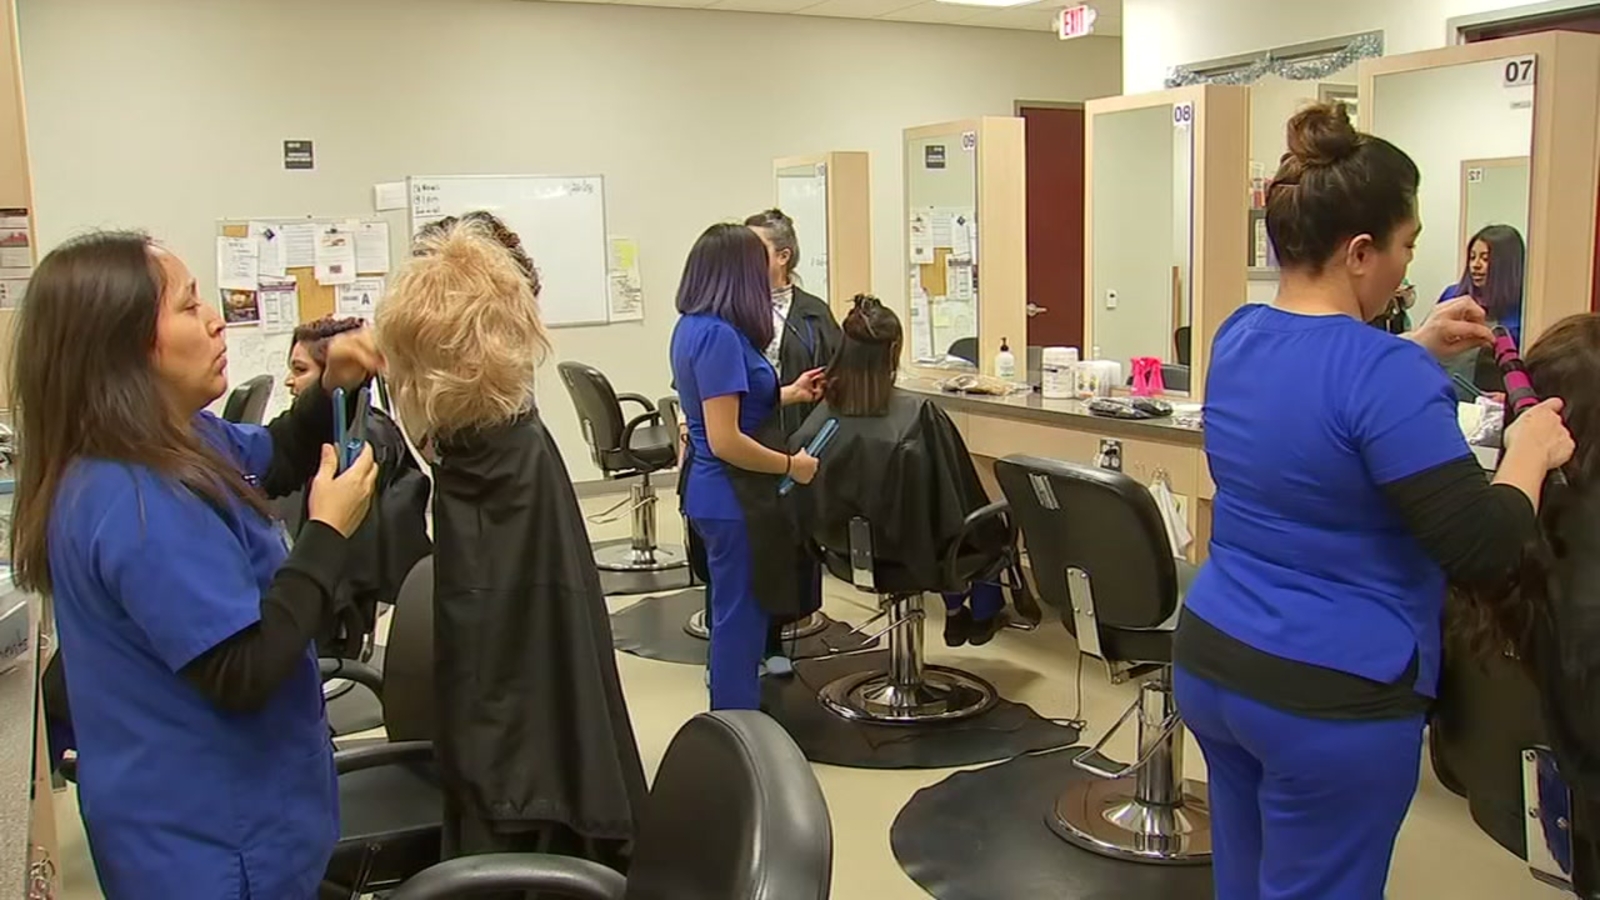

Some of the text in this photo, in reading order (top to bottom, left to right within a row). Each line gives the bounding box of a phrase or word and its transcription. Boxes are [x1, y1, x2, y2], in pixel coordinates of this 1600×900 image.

[1064, 8, 1084, 36] EXIT
[1505, 59, 1533, 82] 07
[1174, 105, 1191, 122] 08
[963, 133, 976, 148] 09
